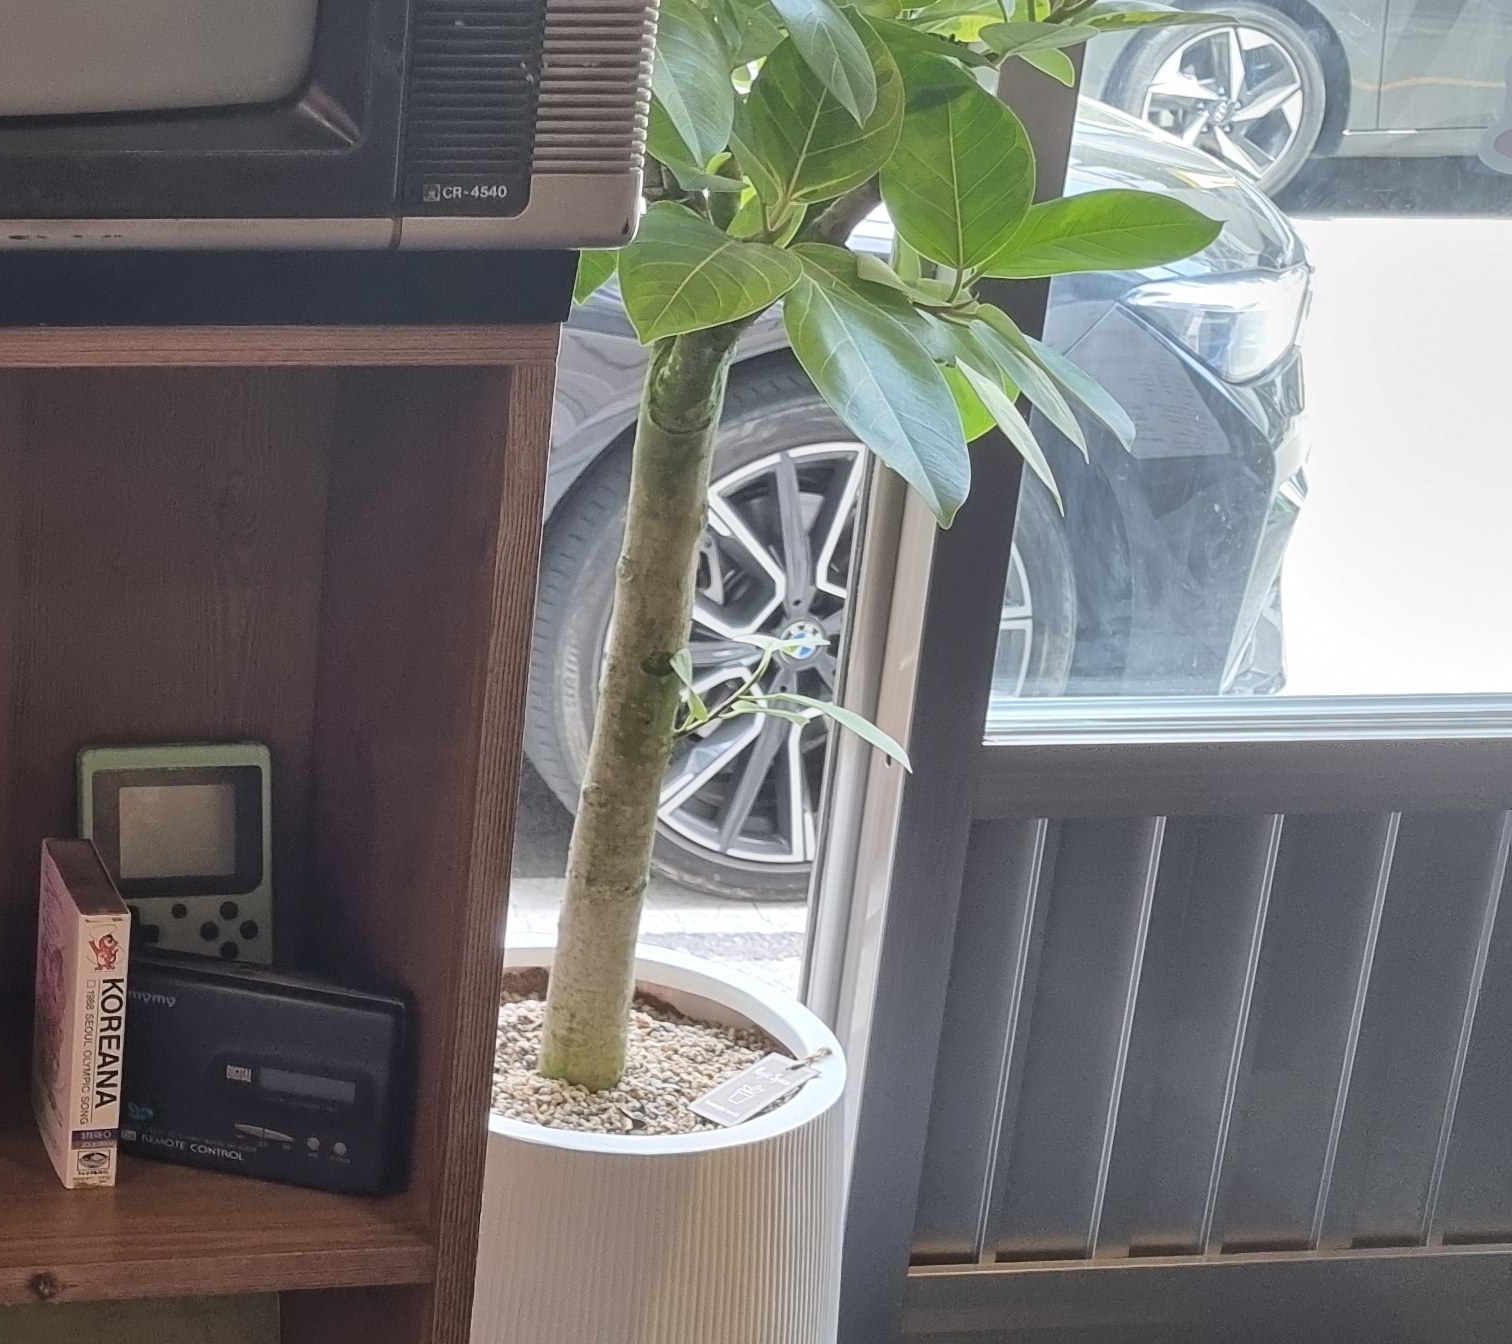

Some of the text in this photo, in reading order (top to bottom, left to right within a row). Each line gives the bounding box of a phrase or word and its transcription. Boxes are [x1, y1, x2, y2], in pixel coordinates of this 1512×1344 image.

[442, 185, 508, 199] CR-4540
[83, 1012, 94, 1048] SEOUL
[94, 978, 125, 1108] KOREANA
[81, 1050, 94, 1095] OLYMPIC
[79, 1096, 91, 1125] SONG
[190, 1143, 245, 1161] CONTROL
